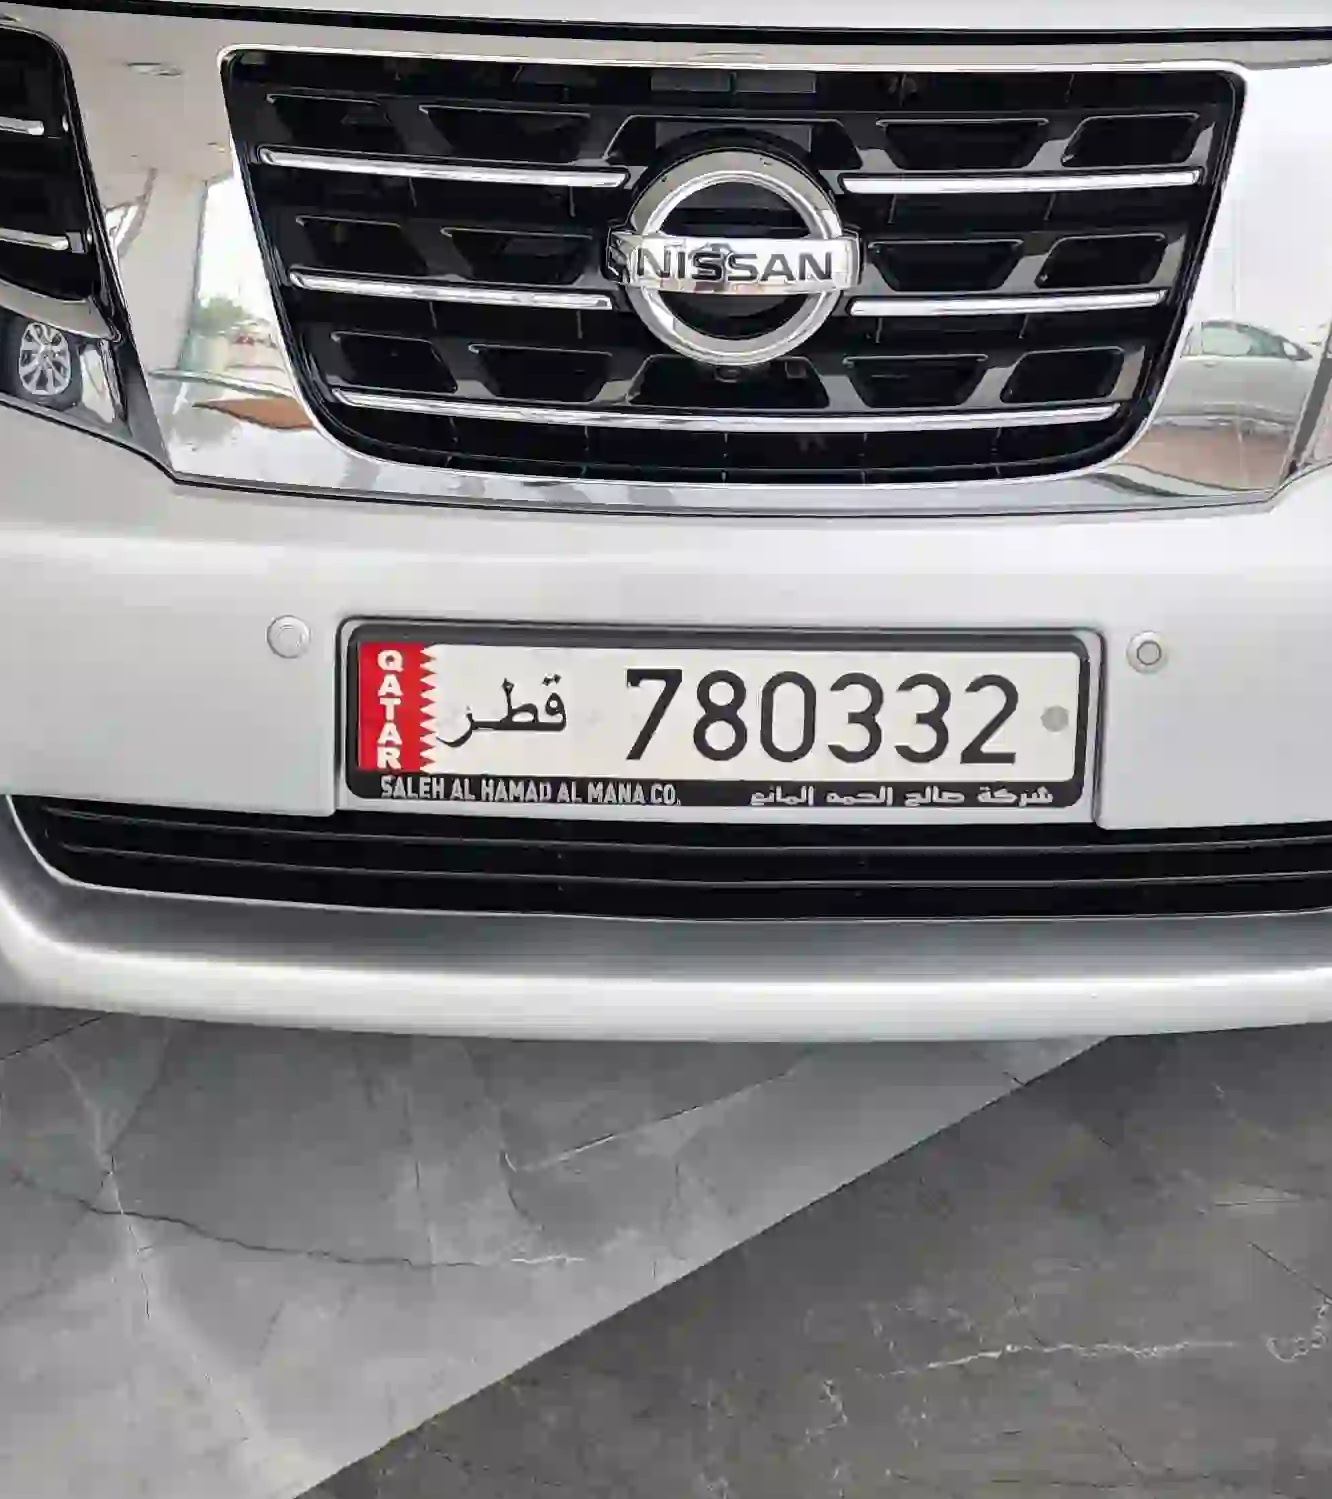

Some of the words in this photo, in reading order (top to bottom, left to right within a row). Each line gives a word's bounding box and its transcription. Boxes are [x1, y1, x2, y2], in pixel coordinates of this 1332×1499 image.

[636, 245, 832, 283] NISSAN
[376, 649, 404, 769] QATAR
[435, 674, 567, 748] قطر
[625, 667, 1020, 765] 780332
[380, 776, 445, 799] SALEH
[449, 777, 476, 800] AL
[481, 779, 552, 802] HAMAD
[557, 781, 582, 803] AL
[588, 782, 644, 804] MANA
[750, 785, 814, 807] المانع
[904, 786, 965, 808] صالح
[977, 785, 1054, 807] شركة
